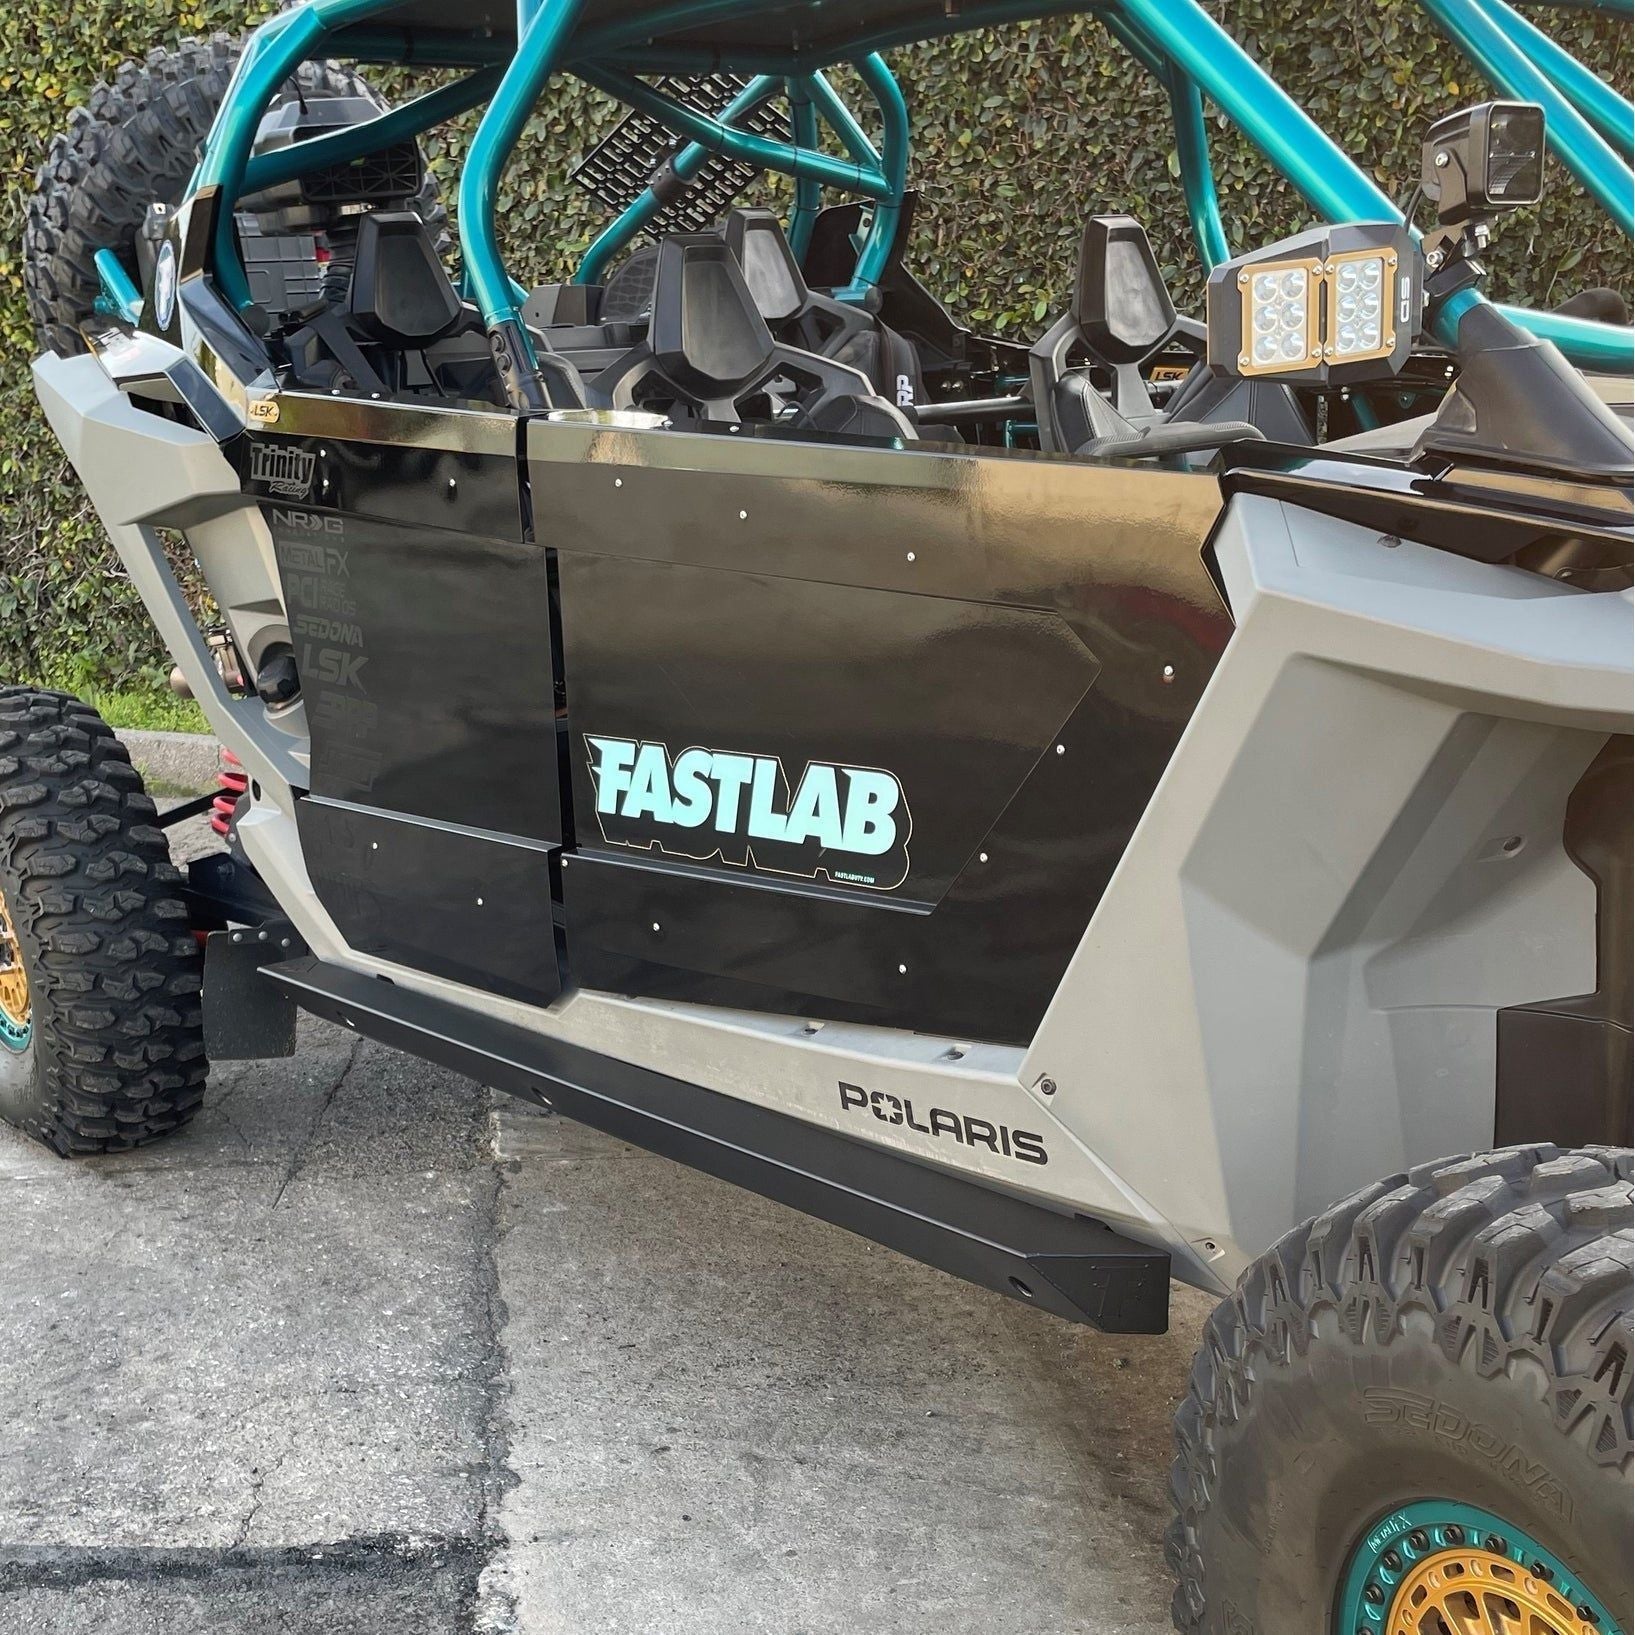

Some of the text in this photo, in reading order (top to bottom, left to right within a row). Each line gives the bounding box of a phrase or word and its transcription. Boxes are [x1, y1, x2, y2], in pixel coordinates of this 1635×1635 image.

[250, 442, 316, 486] Trinity
[286, 572, 319, 609] PCI
[292, 613, 363, 648] SEDONA
[300, 643, 369, 695] LSK
[588, 738, 899, 855] FASTLAB
[838, 1081, 1048, 1166] POLARIS
[1364, 1387, 1575, 1524] SEDONA
